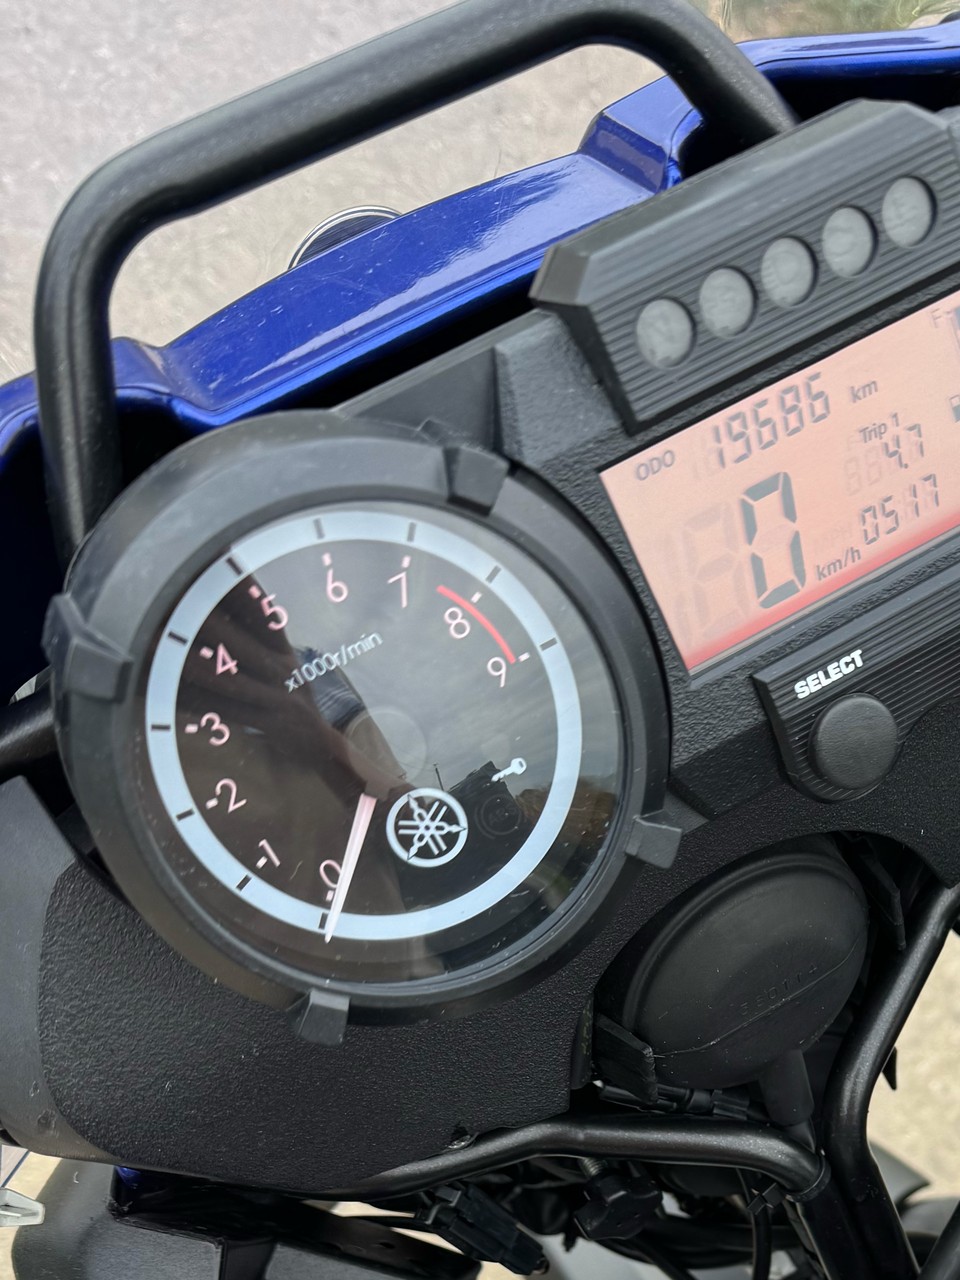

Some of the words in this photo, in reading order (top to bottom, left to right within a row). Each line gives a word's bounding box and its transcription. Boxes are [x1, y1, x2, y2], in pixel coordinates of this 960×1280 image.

[635, 450, 676, 481] ODO
[713, 371, 831, 469] 19686
[850, 380, 879, 404] km
[859, 422, 888, 443] Trip
[891, 412, 900, 427] 1
[861, 473, 939, 545] 0517
[740, 471, 807, 609] 0
[816, 547, 862, 582] km/h
[325, 568, 349, 603] 6
[387, 571, 409, 608] 7
[261, 594, 288, 631] 5
[444, 607, 471, 640] 8
[215, 643, 238, 675] 4
[284, 630, 383, 694] x1000r/min
[486, 656, 507, 688] 9
[794, 649, 864, 699] SELECT
[200, 712, 230, 746] 3
[214, 778, 247, 814] 2
[261, 839, 281, 869] 1
[318, 859, 344, 891] 0
